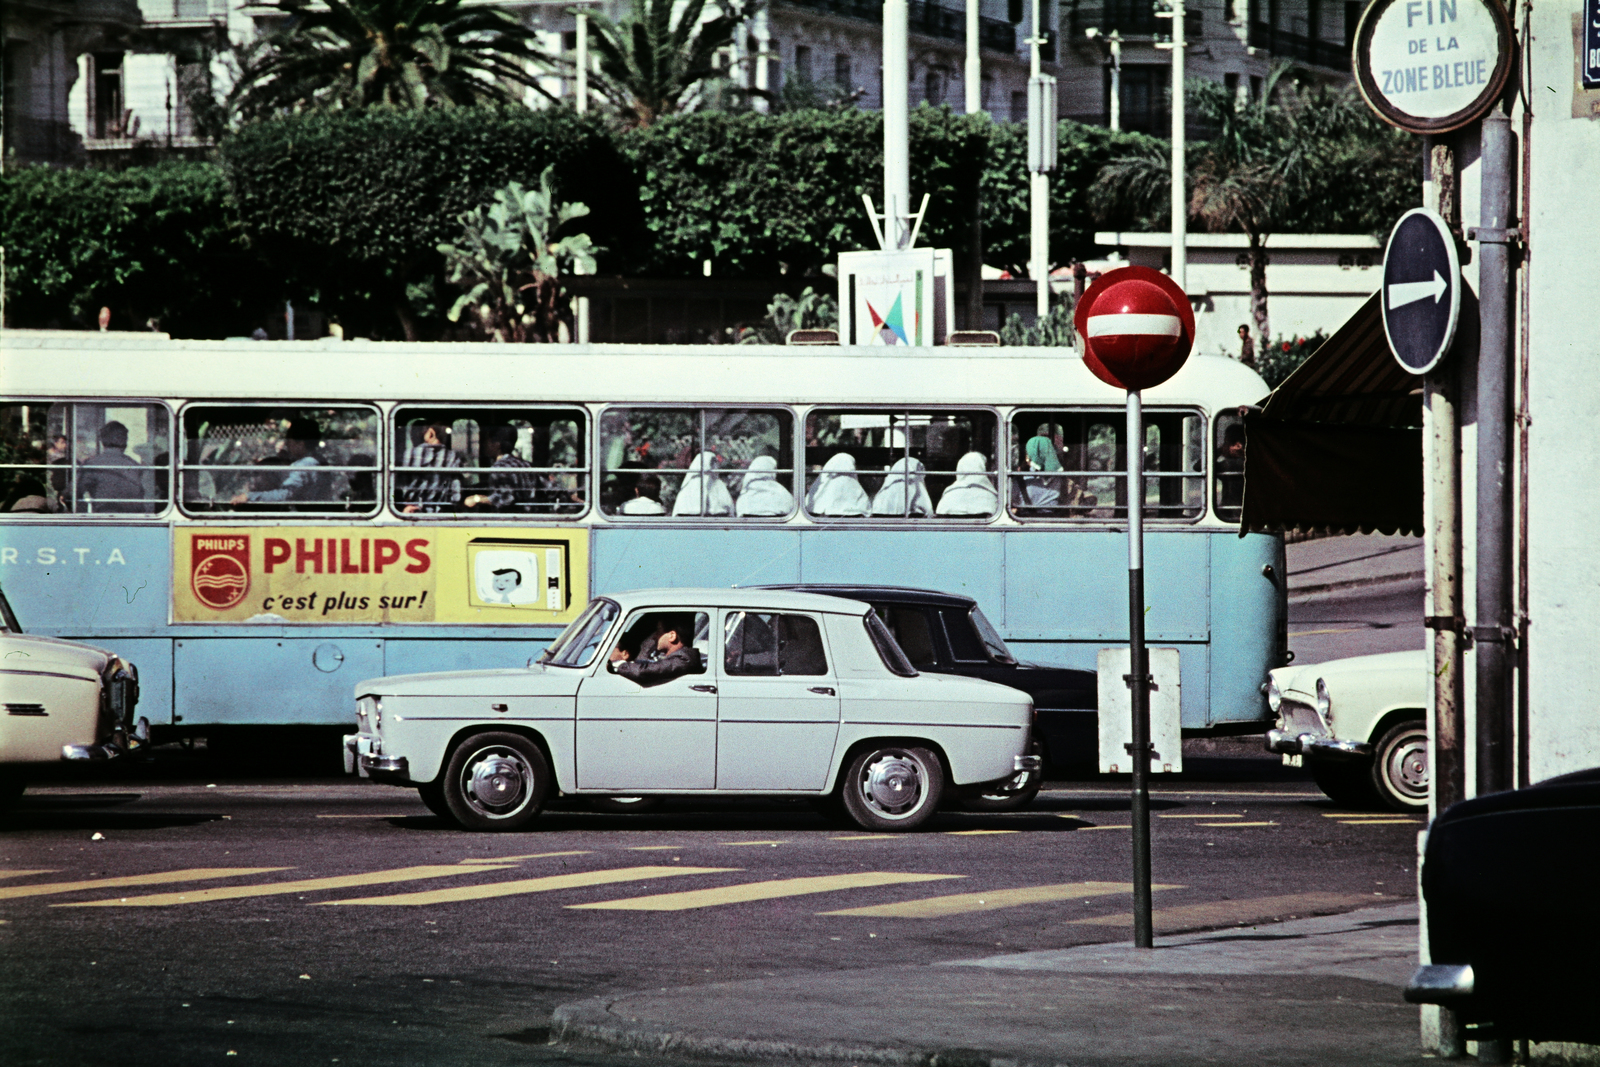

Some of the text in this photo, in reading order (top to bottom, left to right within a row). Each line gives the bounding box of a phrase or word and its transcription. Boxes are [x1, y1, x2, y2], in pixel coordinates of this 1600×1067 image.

[1407, 0, 1457, 28] FIN
[1408, 36, 1459, 54] DE LA
[1382, 59, 1486, 94] ZONE BLEUE
[197, 538, 245, 551] PHILIPS
[263, 538, 431, 574] PHILIPS
[262, 590, 428, 615] c'est plus sur!
